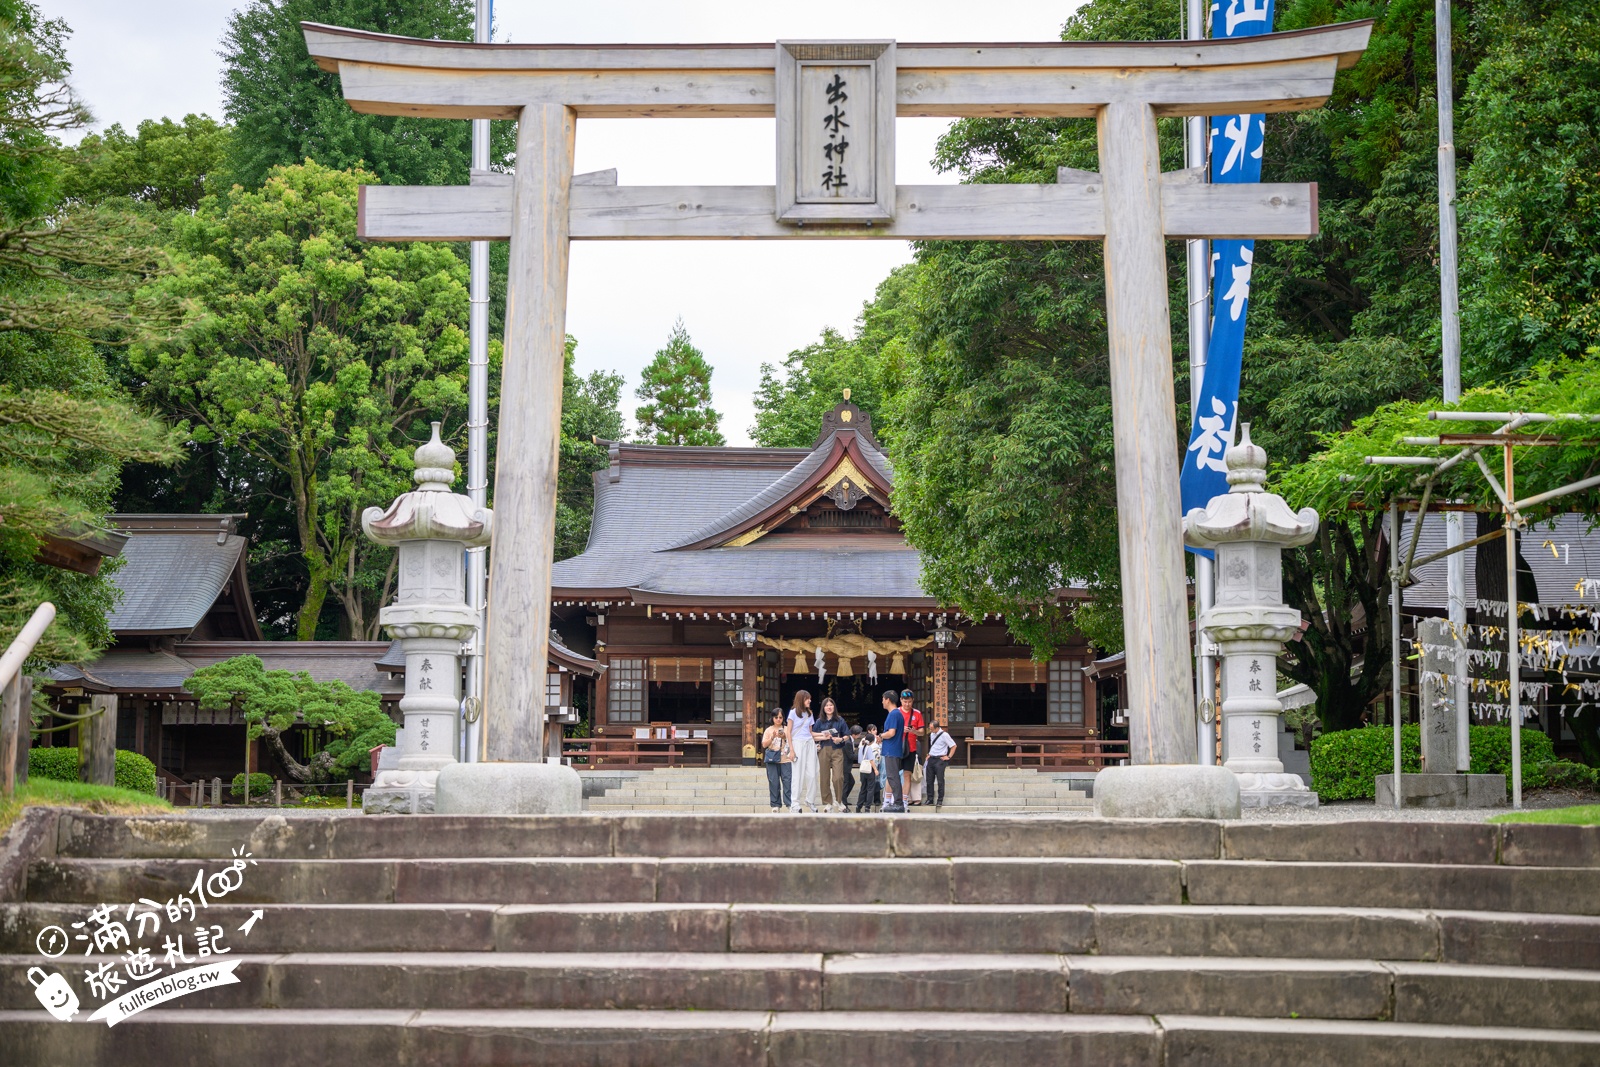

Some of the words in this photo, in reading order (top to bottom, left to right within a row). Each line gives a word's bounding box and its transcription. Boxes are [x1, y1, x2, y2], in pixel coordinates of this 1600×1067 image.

[821, 73, 850, 191] 出水神社
[419, 658, 433, 690] 奉献
[1248, 659, 1262, 692] 奉献
